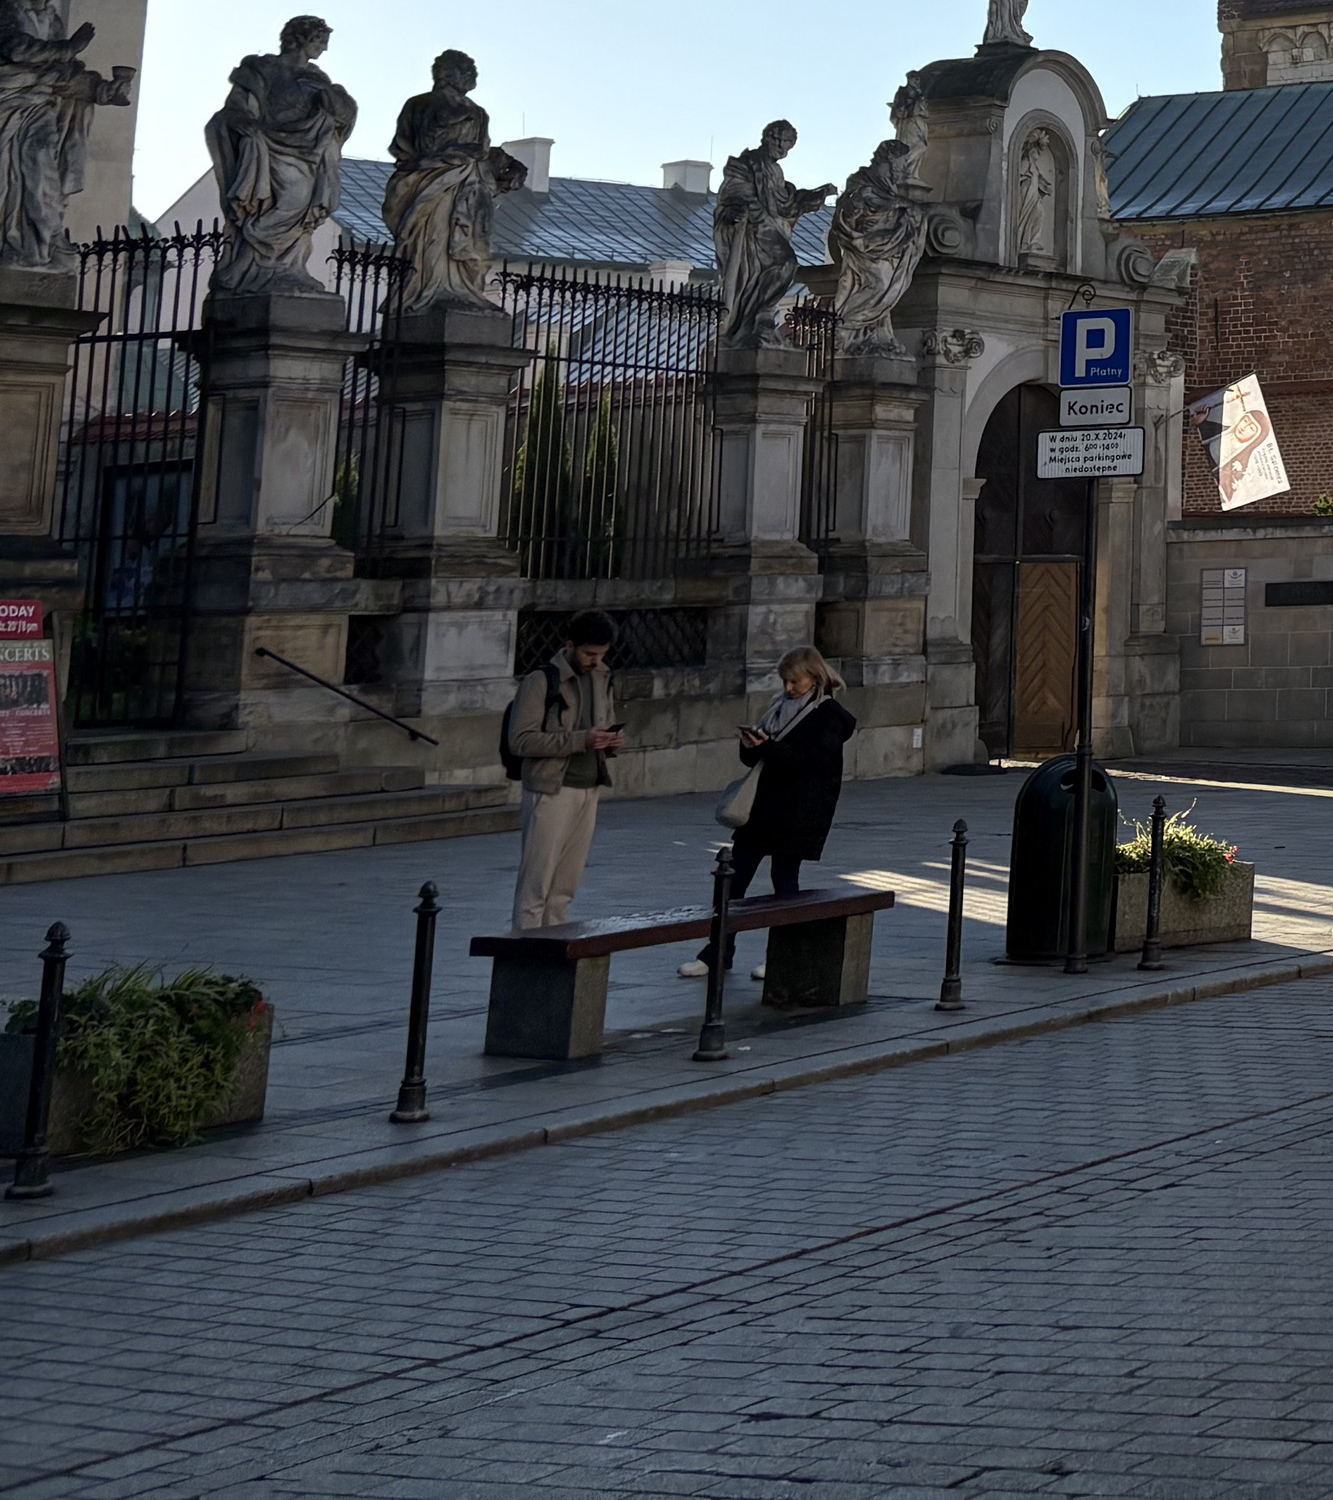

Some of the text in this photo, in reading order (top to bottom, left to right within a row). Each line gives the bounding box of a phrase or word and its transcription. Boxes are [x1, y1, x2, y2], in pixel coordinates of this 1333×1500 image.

[1075, 317, 1116, 377] P
[1090, 367, 1122, 378] Płatny
[1067, 400, 1124, 416] Koniec
[1049, 434, 1057, 443] W
[1060, 433, 1077, 443] dniu
[1049, 452, 1132, 465] Miejsca parkingowe
[0, 605, 35, 617] ODAY
